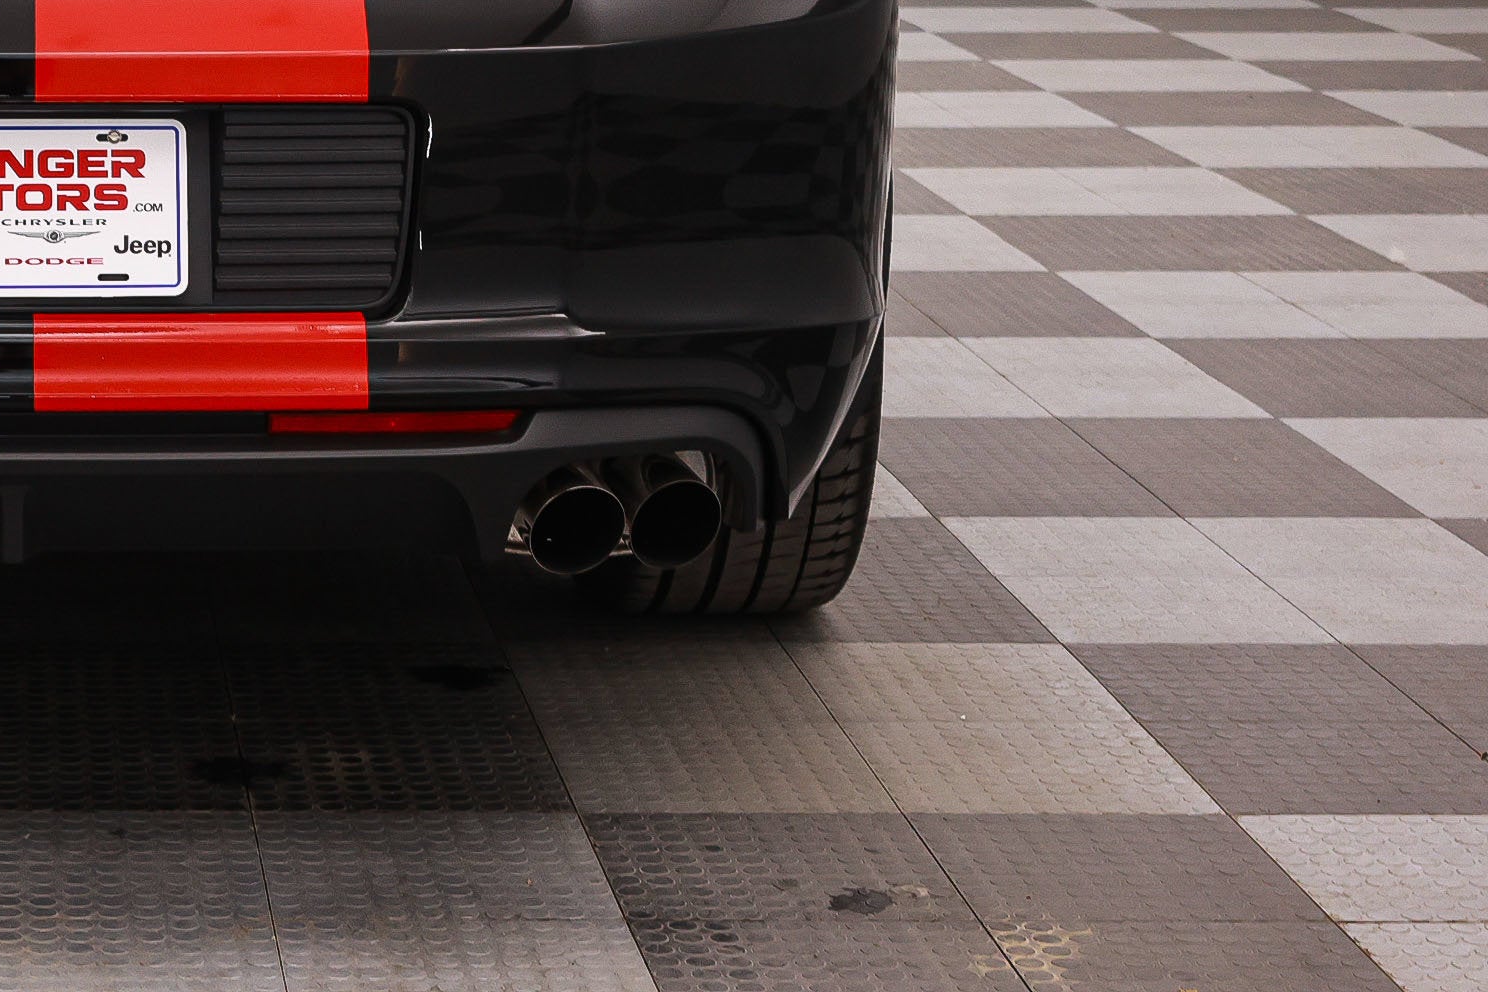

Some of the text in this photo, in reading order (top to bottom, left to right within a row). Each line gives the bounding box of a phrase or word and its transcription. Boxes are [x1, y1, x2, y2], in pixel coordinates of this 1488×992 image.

[132, 203, 163, 213] .COM
[1, 218, 108, 226] CHRYSLER
[113, 234, 172, 258] Jeep
[4, 257, 104, 265] DODGE
